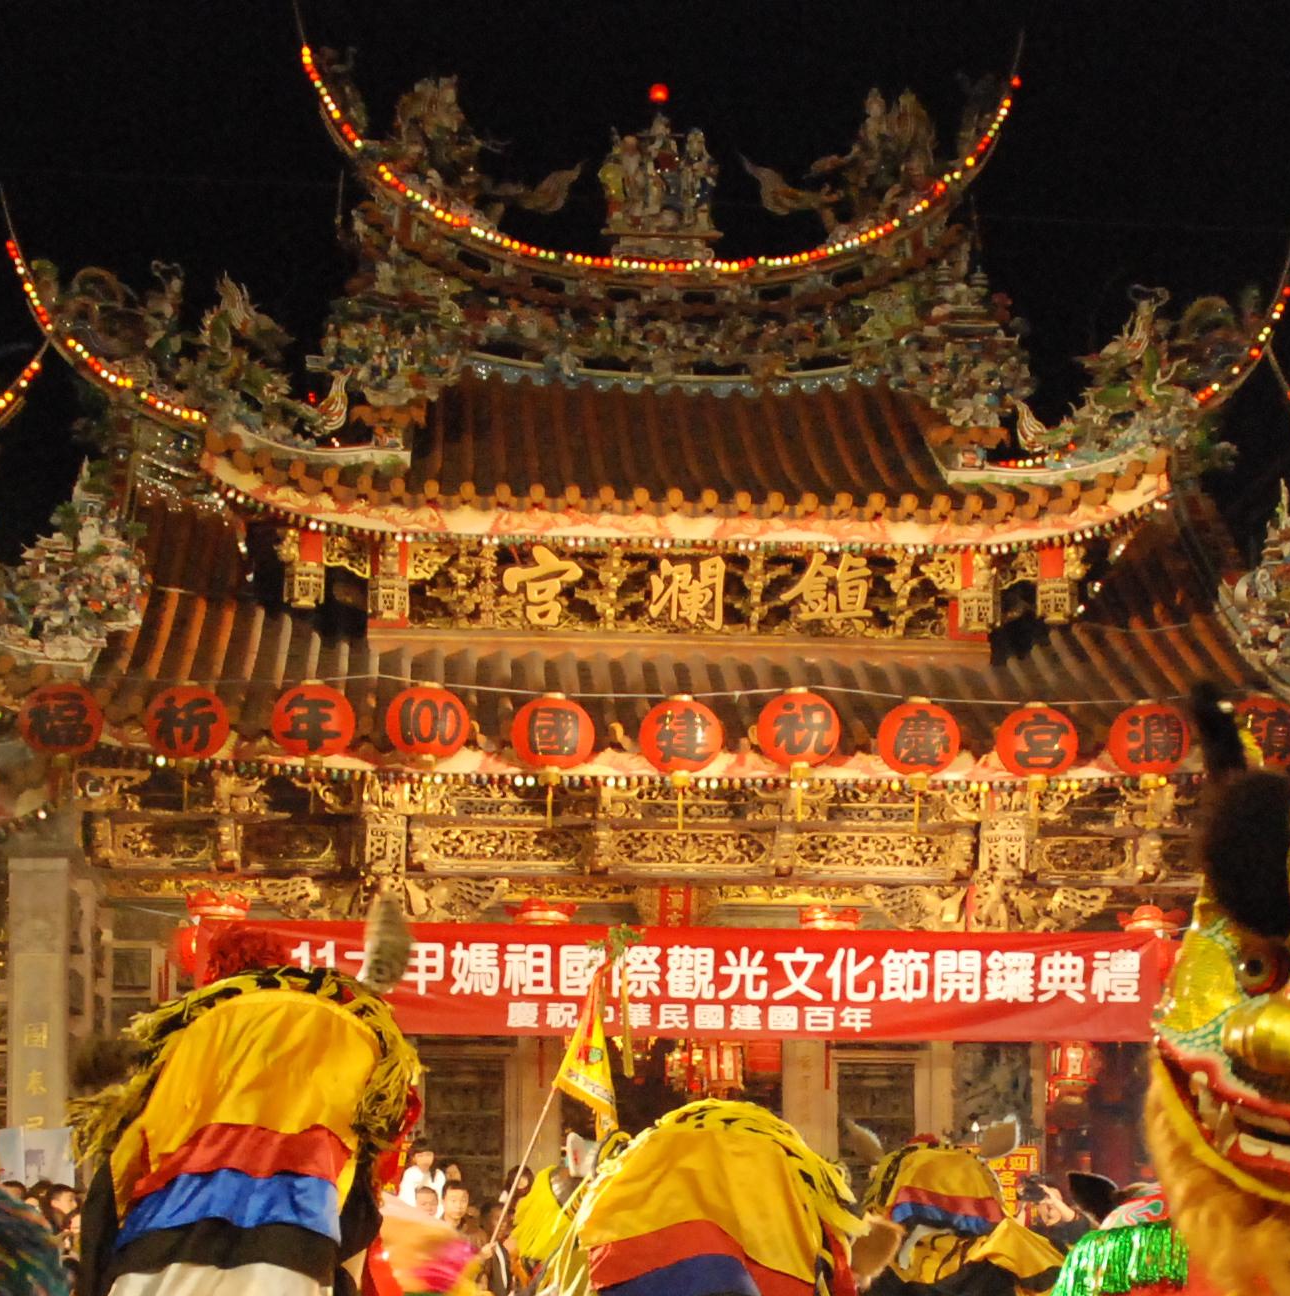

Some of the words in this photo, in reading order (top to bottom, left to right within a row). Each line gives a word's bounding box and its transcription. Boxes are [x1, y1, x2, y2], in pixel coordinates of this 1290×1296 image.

[155, 695, 218, 752] 祈
[281, 693, 342, 752] 年
[399, 697, 462, 747] 100
[528, 707, 579, 757] 國
[656, 707, 713, 763] 建
[773, 702, 833, 756] 祝
[893, 709, 952, 766] 慶
[1013, 713, 1069, 769] 宮
[1126, 713, 1184, 763] 瀾
